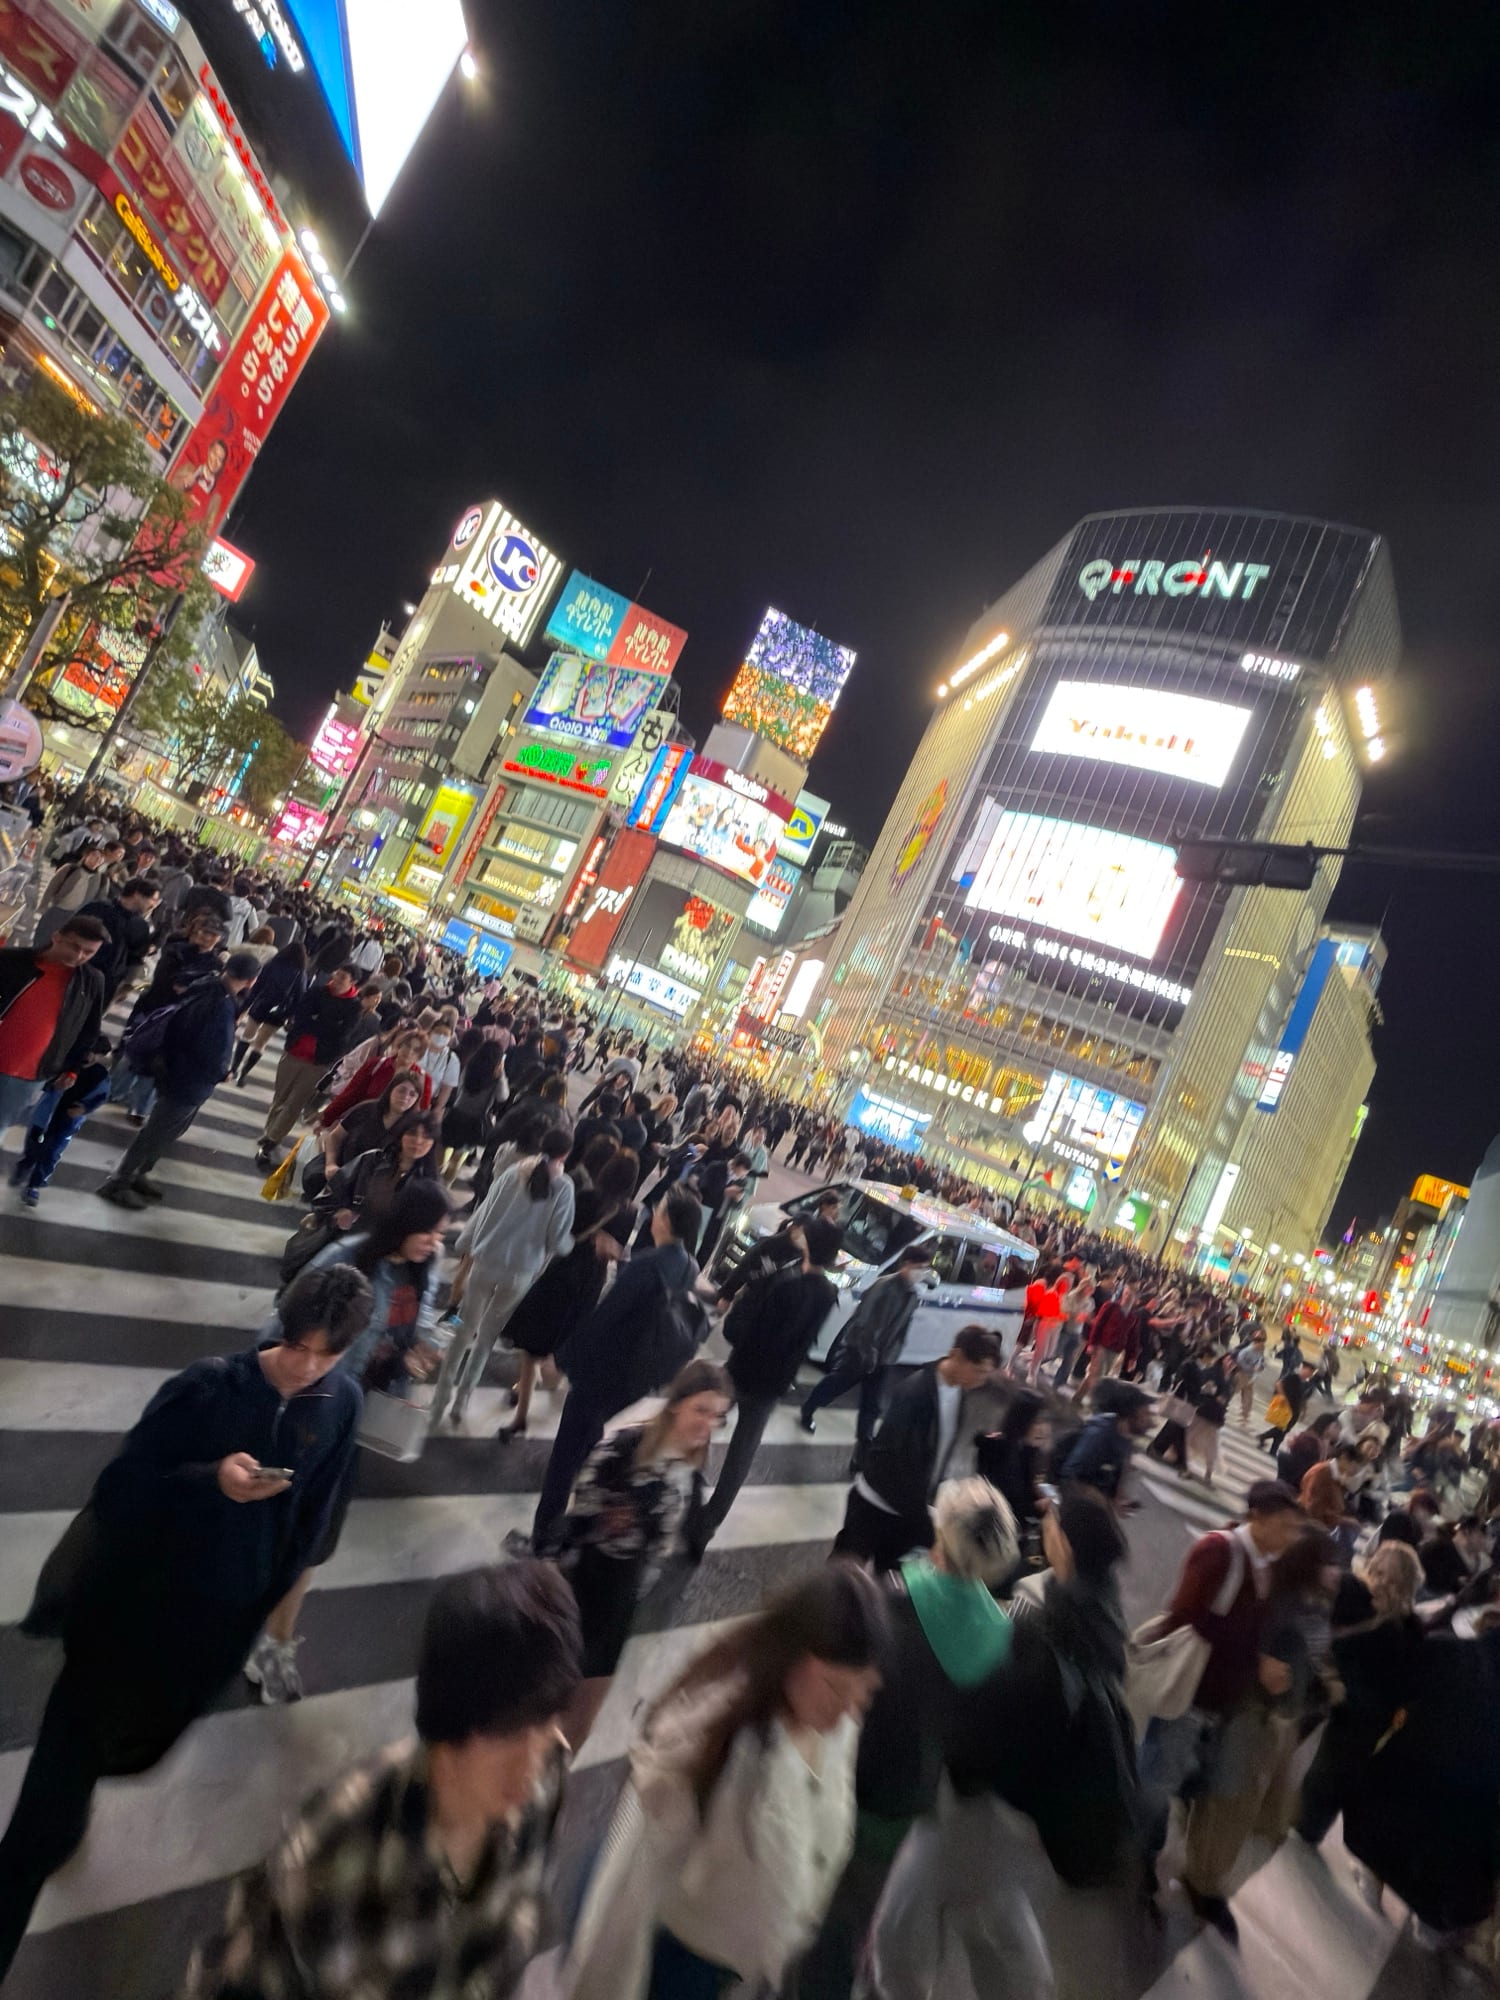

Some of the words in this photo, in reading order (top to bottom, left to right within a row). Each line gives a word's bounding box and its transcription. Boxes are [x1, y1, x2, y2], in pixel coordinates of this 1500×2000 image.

[120, 126, 220, 289] コンタクト
[174, 282, 222, 352] ガスト
[240, 269, 301, 398] 推しから。
[257, 295, 315, 420] 買うなら、
[493, 536, 536, 590] UC
[1079, 558, 1271, 601] QFRONT
[1241, 653, 1301, 681] QFRONT
[615, 966, 692, 1008] 盛堂書店
[884, 1055, 1005, 1115] STARBUCKS
[1052, 1140, 1100, 1171] TSUTAYA
